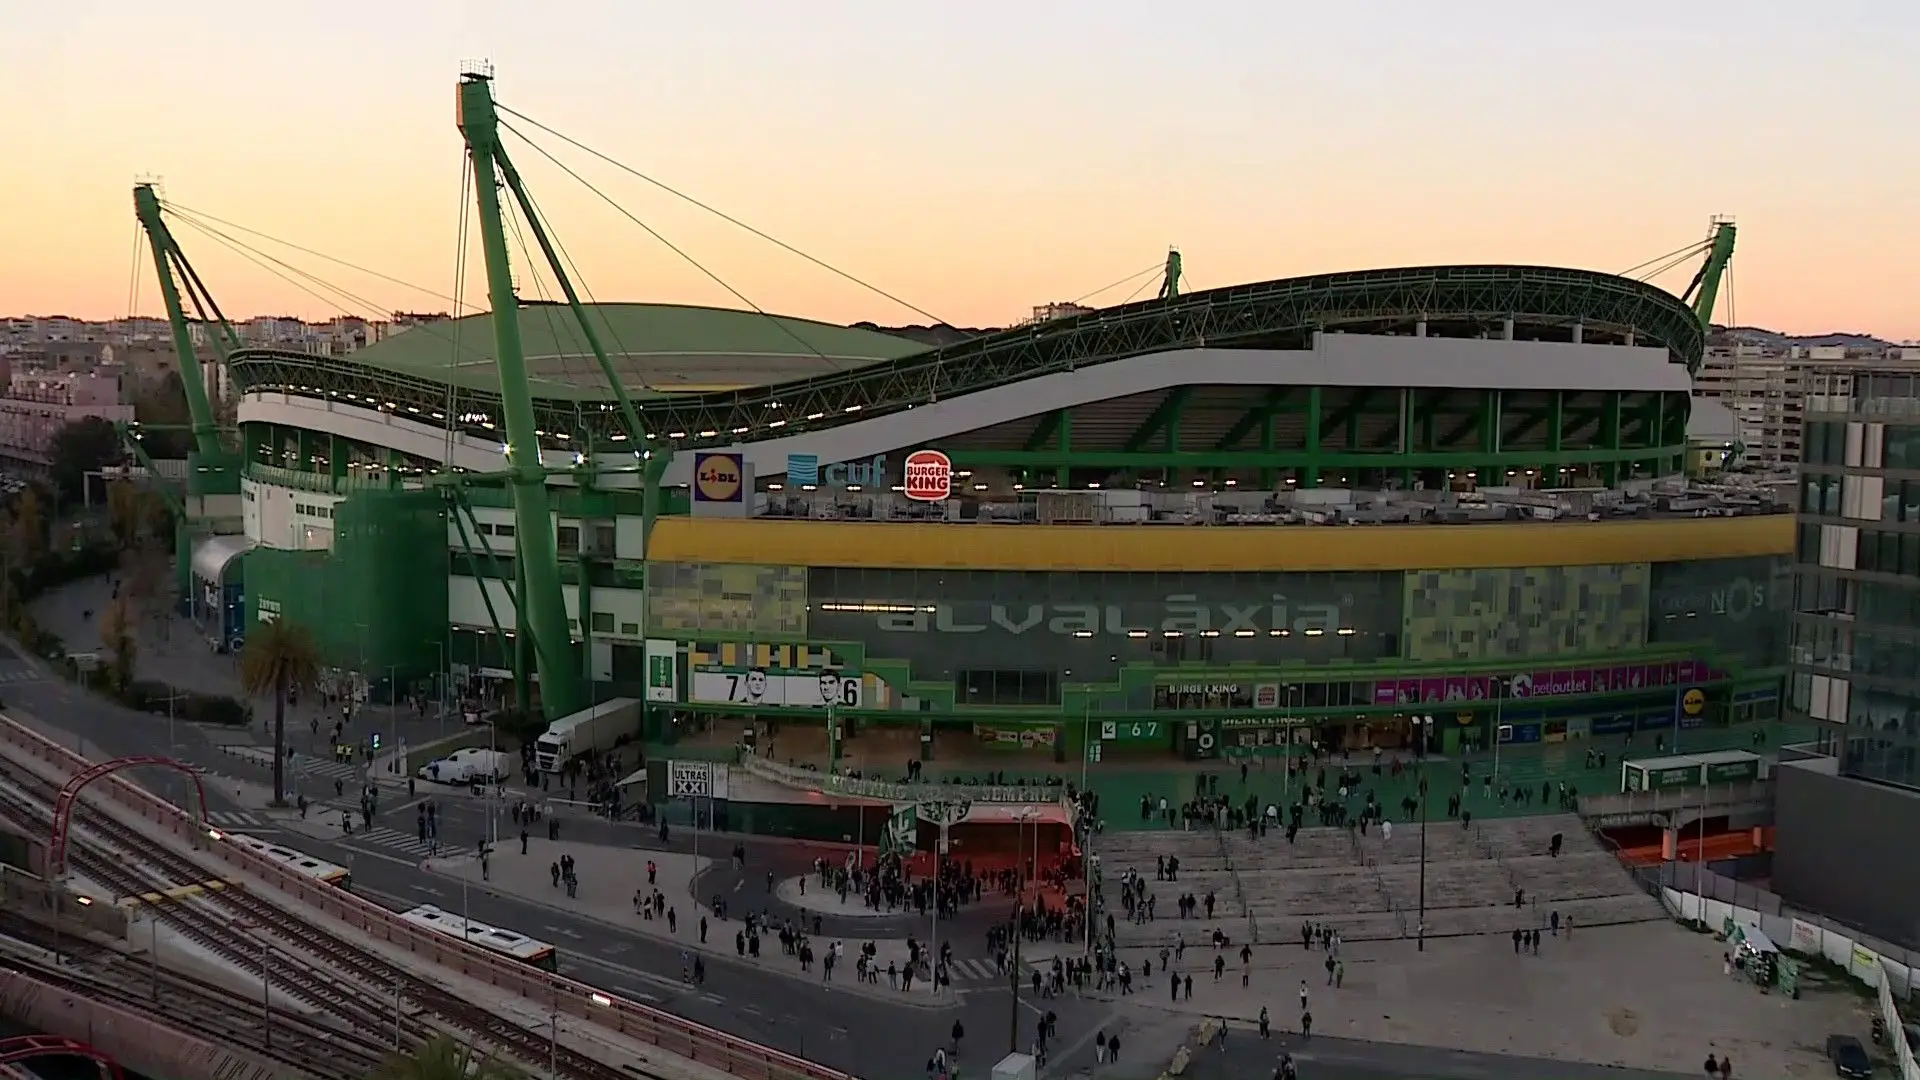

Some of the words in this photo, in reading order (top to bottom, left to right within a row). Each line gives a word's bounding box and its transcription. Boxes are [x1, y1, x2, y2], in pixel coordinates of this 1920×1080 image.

[825, 455, 887, 488] cuf
[906, 466, 948, 476] BURGER
[907, 477, 948, 489] KING
[1710, 576, 1764, 621] NOS
[726, 676, 738, 701] 7
[843, 679, 857, 706] 6
[1132, 722, 1141, 736] 6
[1147, 722, 1157, 736] 7
[675, 770, 707, 780] ULTRAS
[676, 781, 707, 794] XXI
